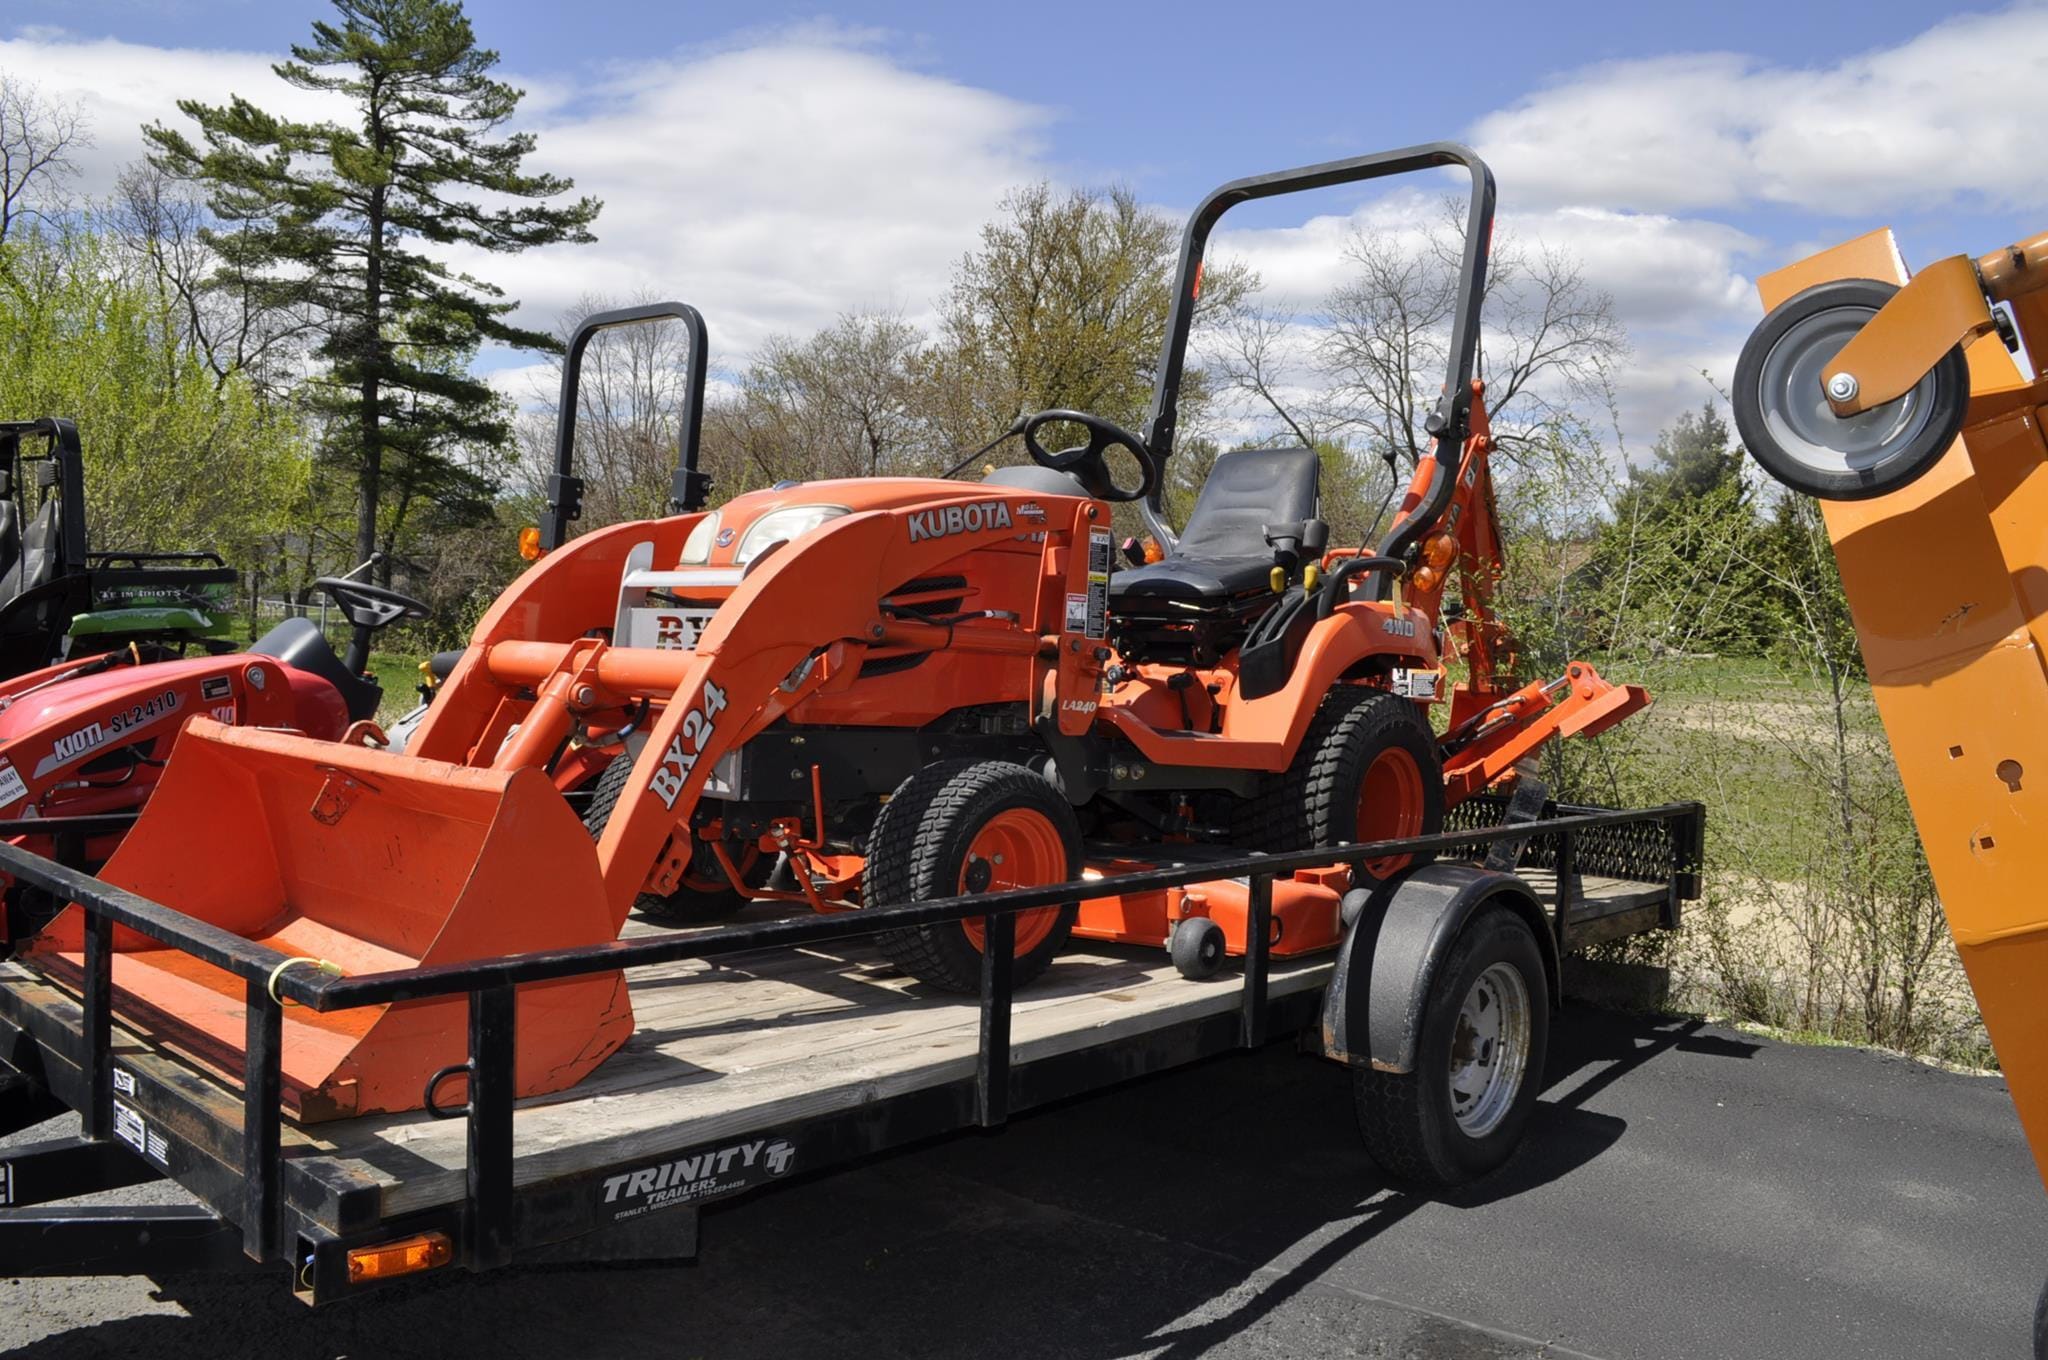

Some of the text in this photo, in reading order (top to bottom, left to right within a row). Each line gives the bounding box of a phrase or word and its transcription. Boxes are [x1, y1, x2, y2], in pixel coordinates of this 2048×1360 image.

[908, 502, 1012, 543] KUBOTA
[111, 691, 176, 733] SL2410
[1062, 700, 1097, 715] LA240
[53, 722, 104, 762] KIOTI
[648, 679, 729, 810] BX24
[603, 1140, 766, 1203] TRINITY
[646, 1177, 717, 1205] TRAILERS
[614, 1206, 648, 1221] STANLEY,
